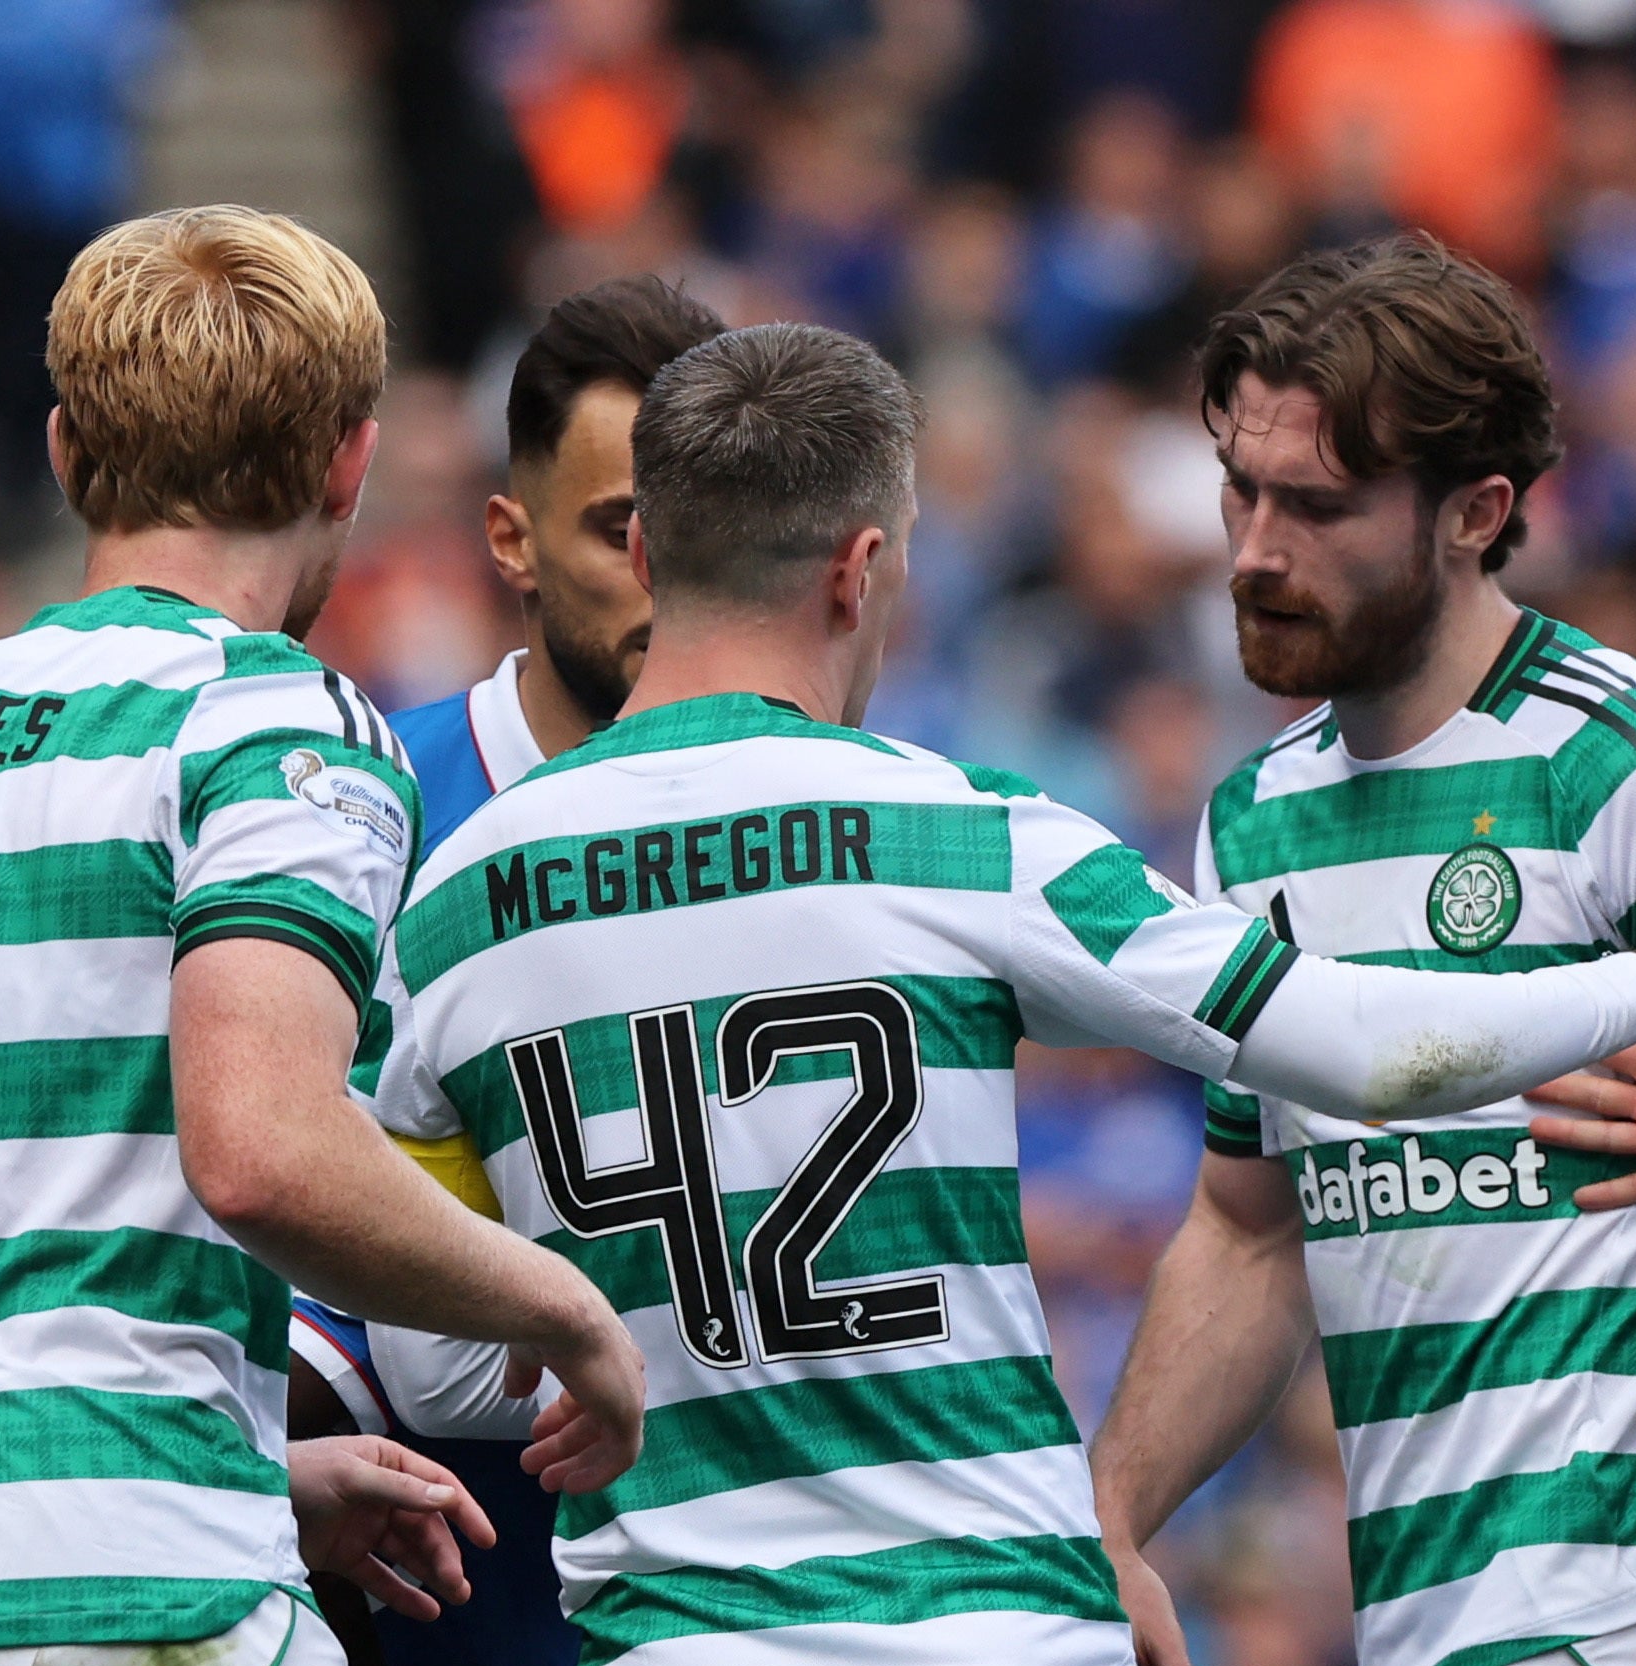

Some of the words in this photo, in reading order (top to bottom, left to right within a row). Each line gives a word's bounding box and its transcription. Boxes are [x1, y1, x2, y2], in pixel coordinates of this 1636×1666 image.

[385, 802, 404, 832] HILL
[1440, 855, 1465, 881] CELTIC
[1467, 850, 1505, 873] FOOTBALL
[1500, 871, 1515, 900] CLUB
[505, 981, 949, 1370] 42
[1298, 1137, 1550, 1237] dafabet
